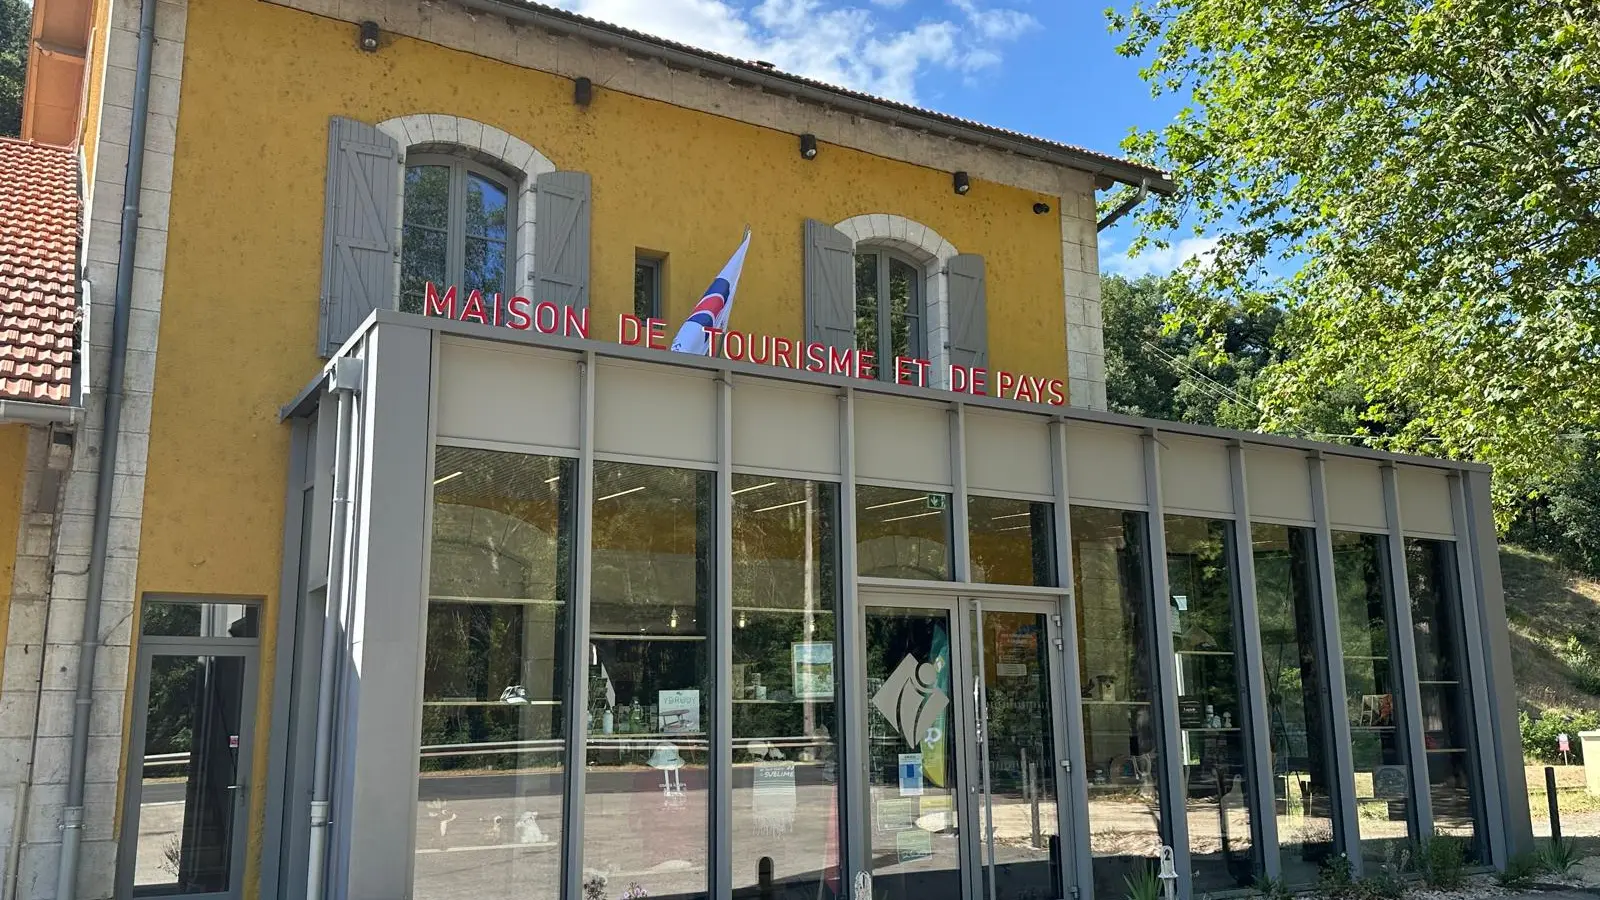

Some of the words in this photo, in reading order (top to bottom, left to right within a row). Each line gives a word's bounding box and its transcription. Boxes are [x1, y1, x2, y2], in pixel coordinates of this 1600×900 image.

[424, 281, 589, 339] MAISON
[619, 313, 667, 350] DE
[702, 326, 875, 379] TOURISME
[895, 356, 931, 387] ET
[950, 364, 987, 396] DE
[997, 371, 1065, 406] PAYS
[1164, 849, 1171, 861] 2
